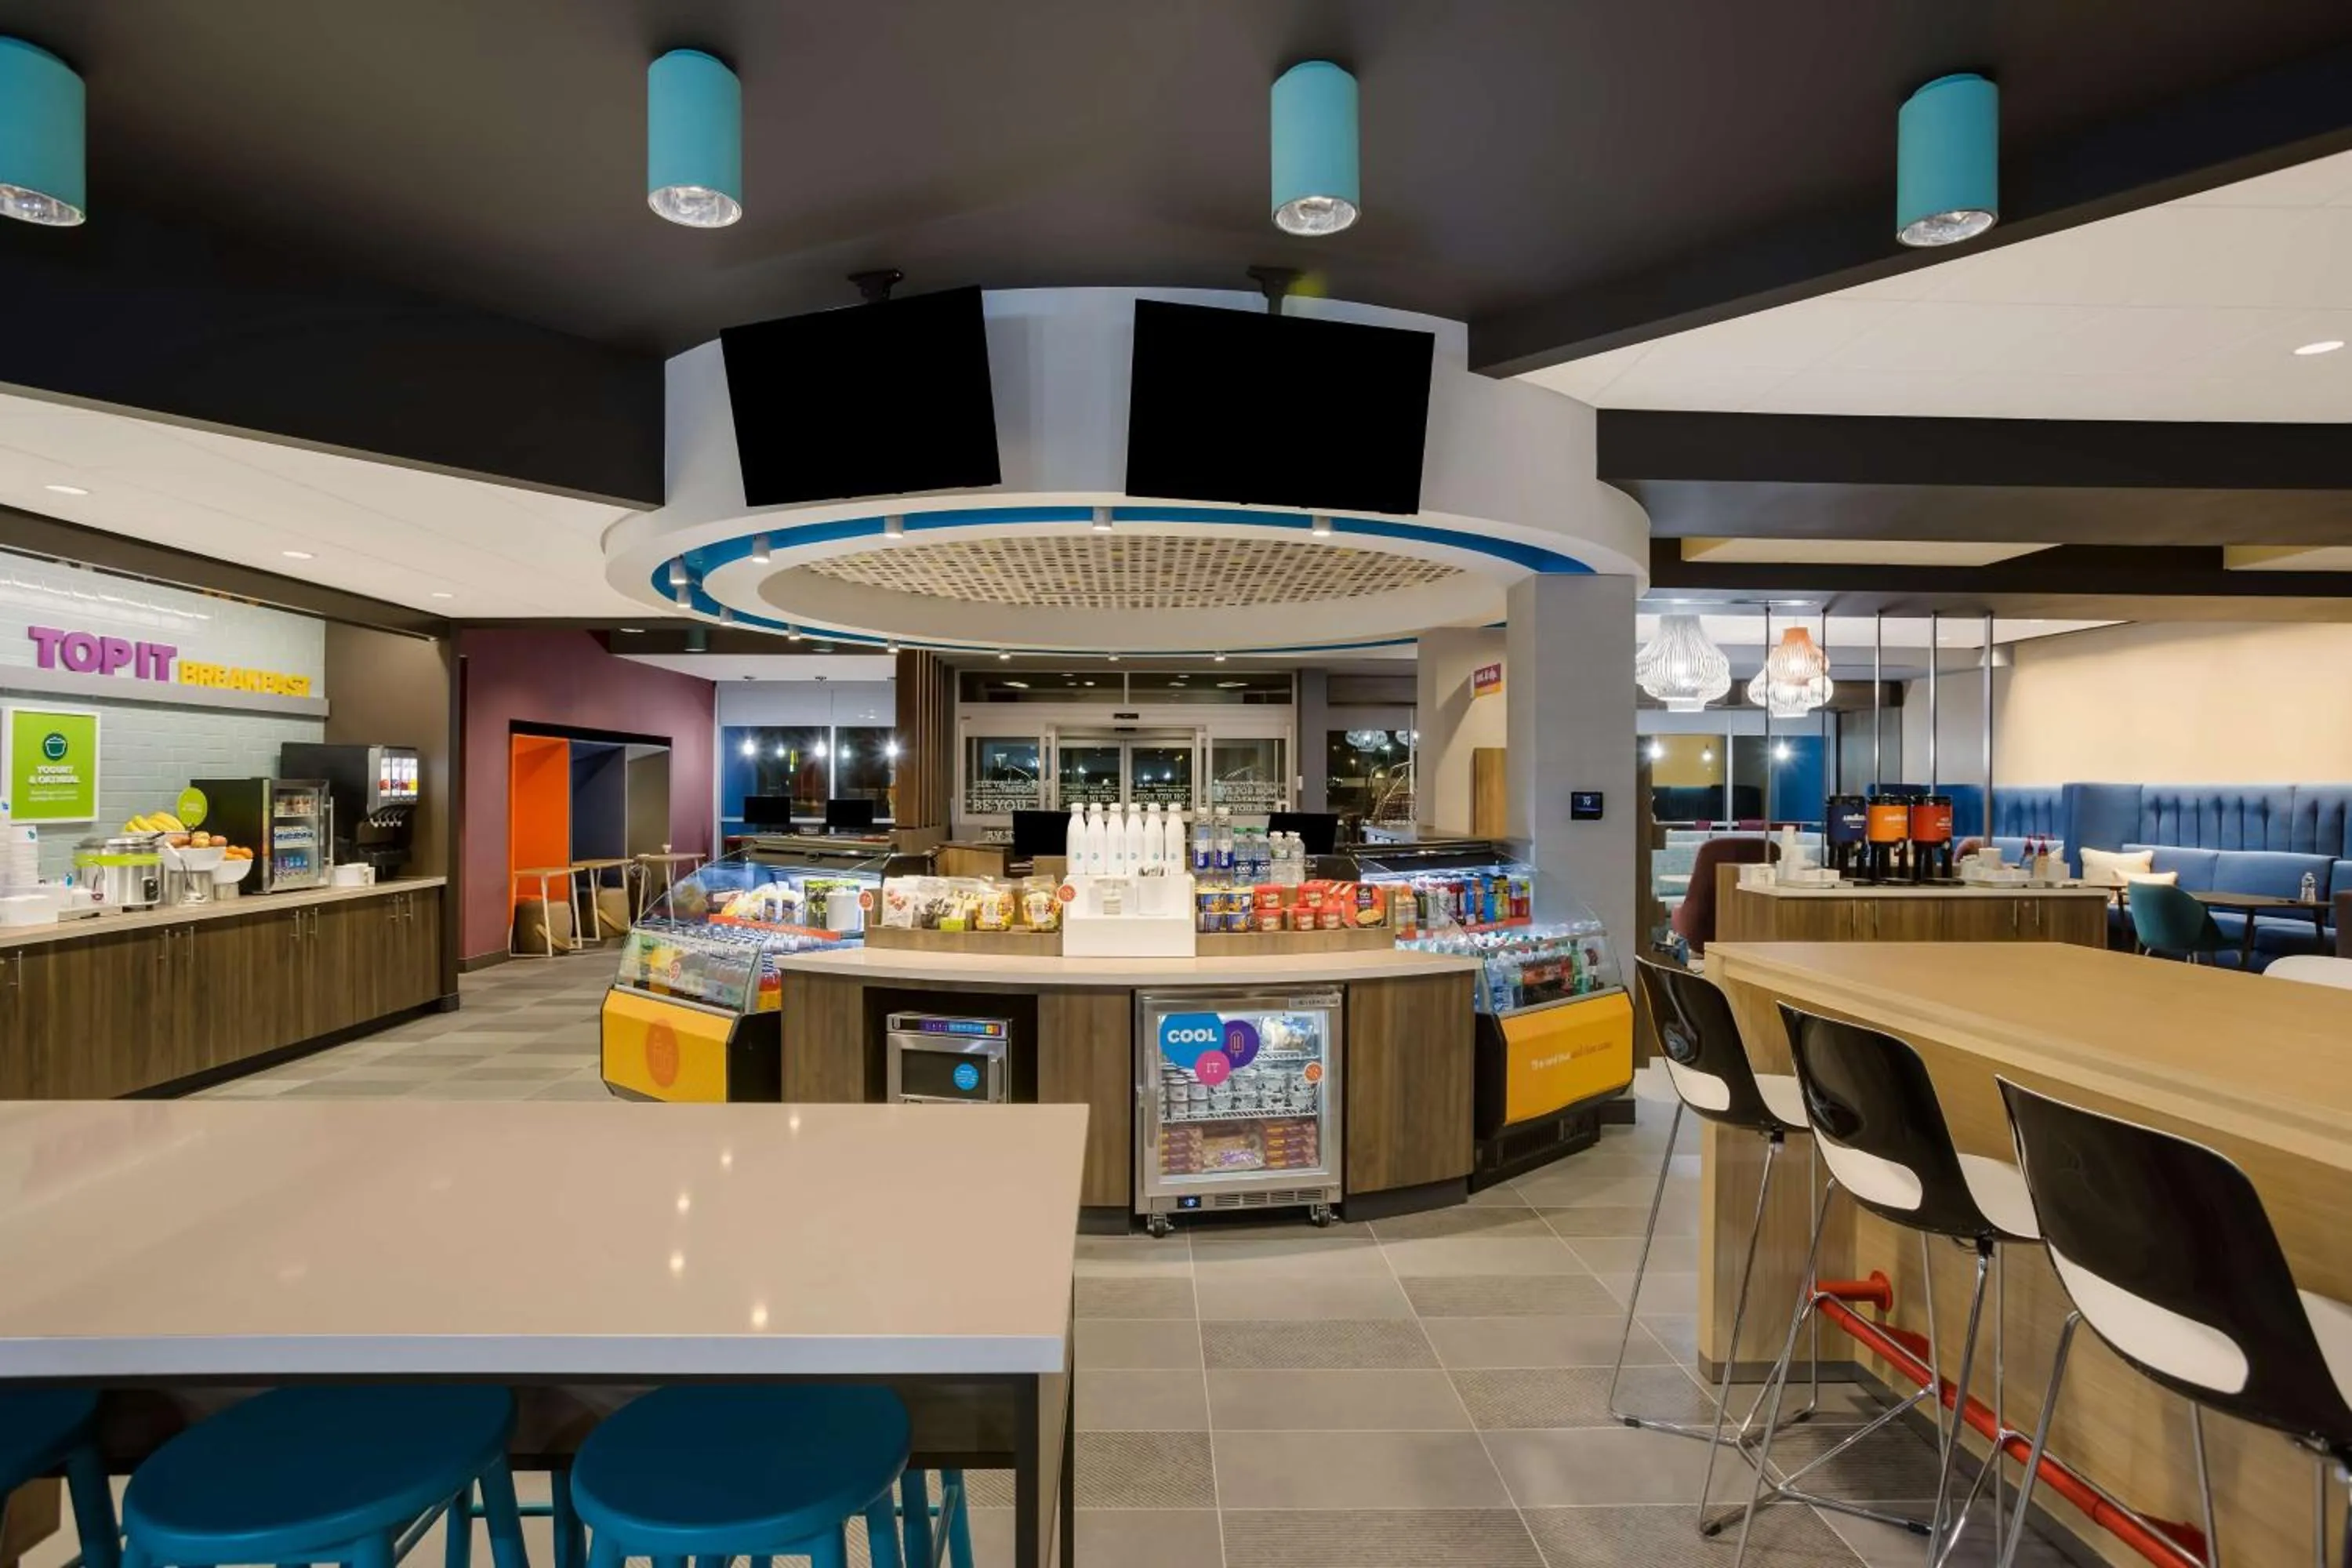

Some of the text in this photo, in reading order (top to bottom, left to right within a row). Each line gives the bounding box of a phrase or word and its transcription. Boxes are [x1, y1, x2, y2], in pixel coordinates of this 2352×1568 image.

[28, 626, 311, 698] TOP IT BREAKFAST
[1167, 1029, 1217, 1044] COOL
[1205, 1062, 1220, 1074] IT
